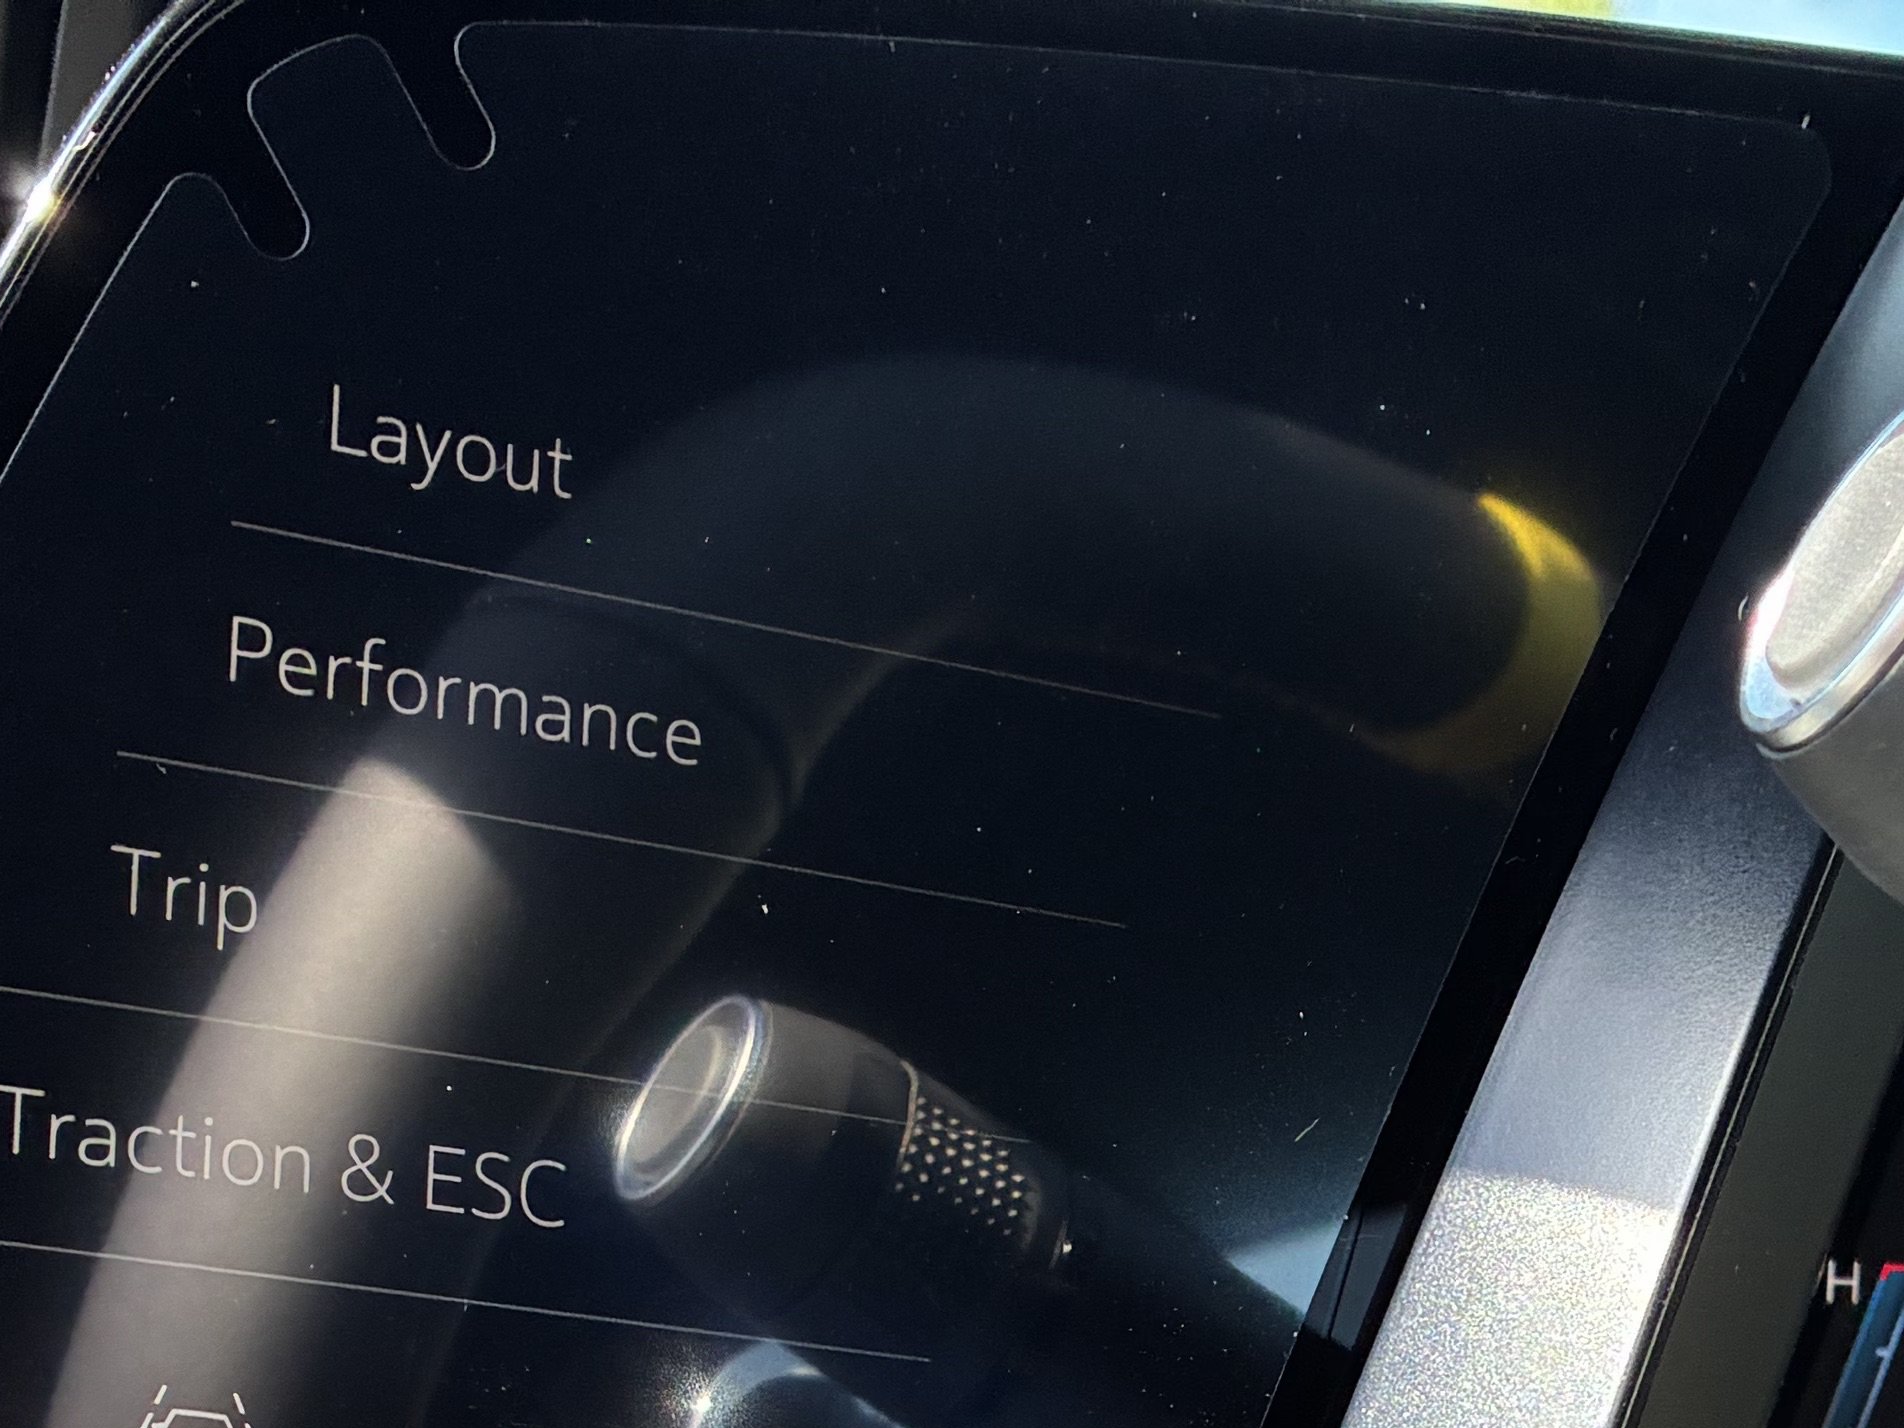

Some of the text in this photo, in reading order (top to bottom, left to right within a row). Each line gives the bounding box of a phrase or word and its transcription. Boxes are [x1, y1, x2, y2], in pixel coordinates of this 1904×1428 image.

[329, 383, 573, 499] Layout
[227, 615, 702, 767] Performance
[110, 844, 258, 951] Trip
[339, 1133, 396, 1205] &
[425, 1144, 567, 1228] ESC
[1825, 1258, 1861, 1305] H
